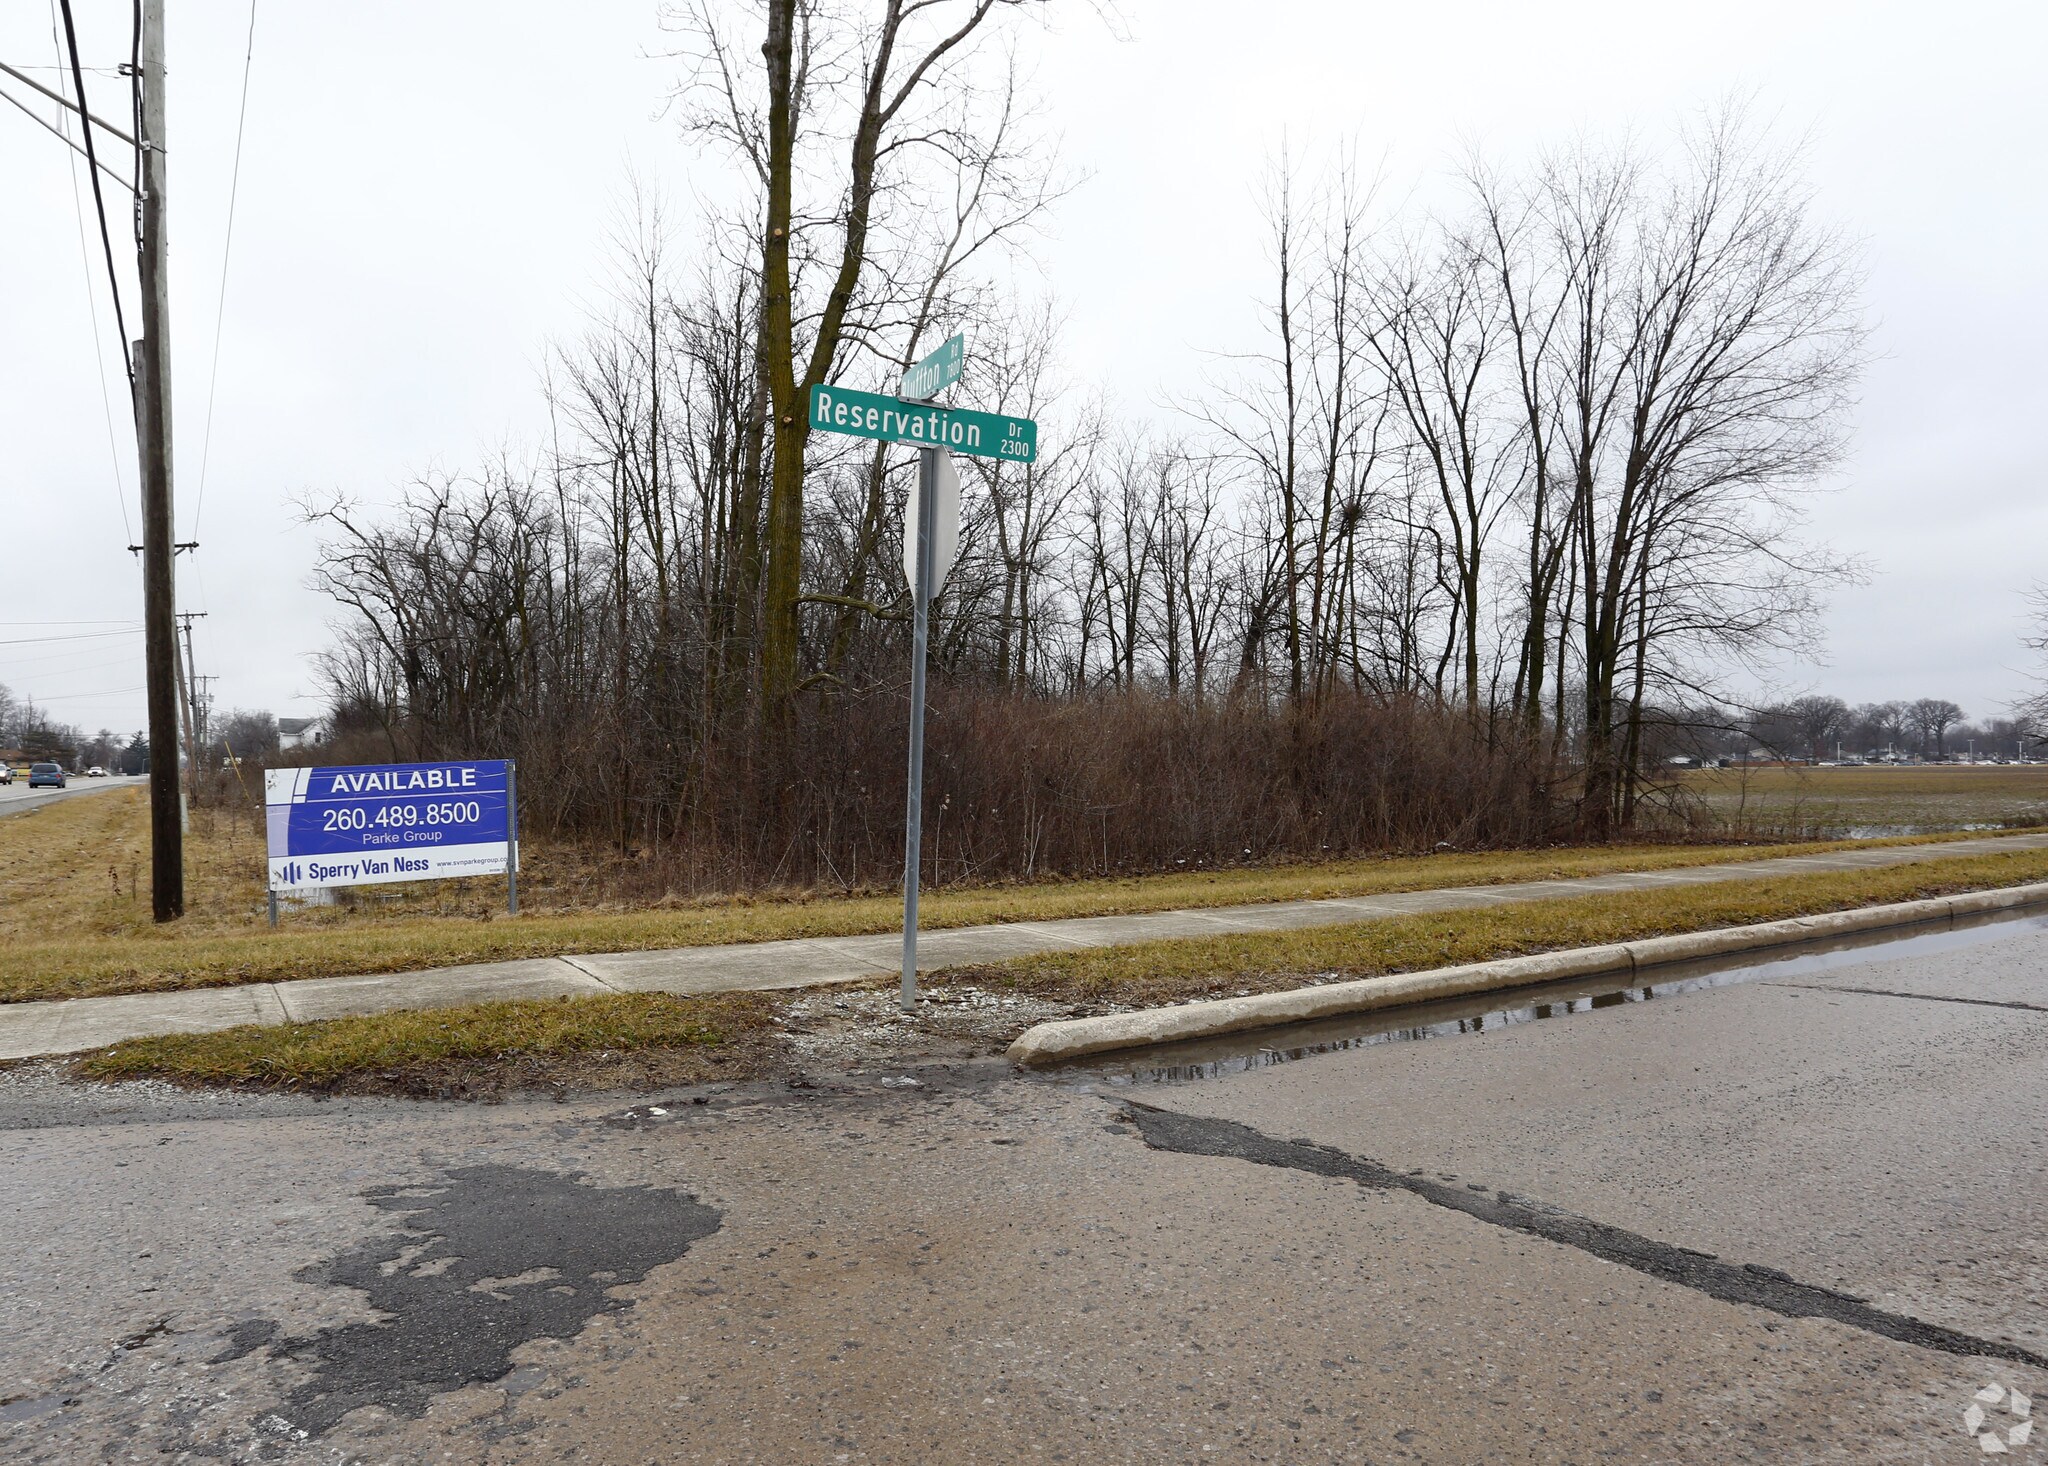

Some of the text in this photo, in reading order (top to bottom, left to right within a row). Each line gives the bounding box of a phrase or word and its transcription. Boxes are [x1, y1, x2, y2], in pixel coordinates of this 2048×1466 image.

[950, 341, 959, 359] Rd
[818, 393, 1023, 447] Reservation Dr
[1001, 439, 1029, 457] 2300
[331, 768, 476, 792] AVAILABLE
[323, 801, 480, 832] 260.489.8500
[362, 830, 443, 845] Parke Group
[308, 856, 508, 882] Sperry Van Ness www.svnparkegroup.co
